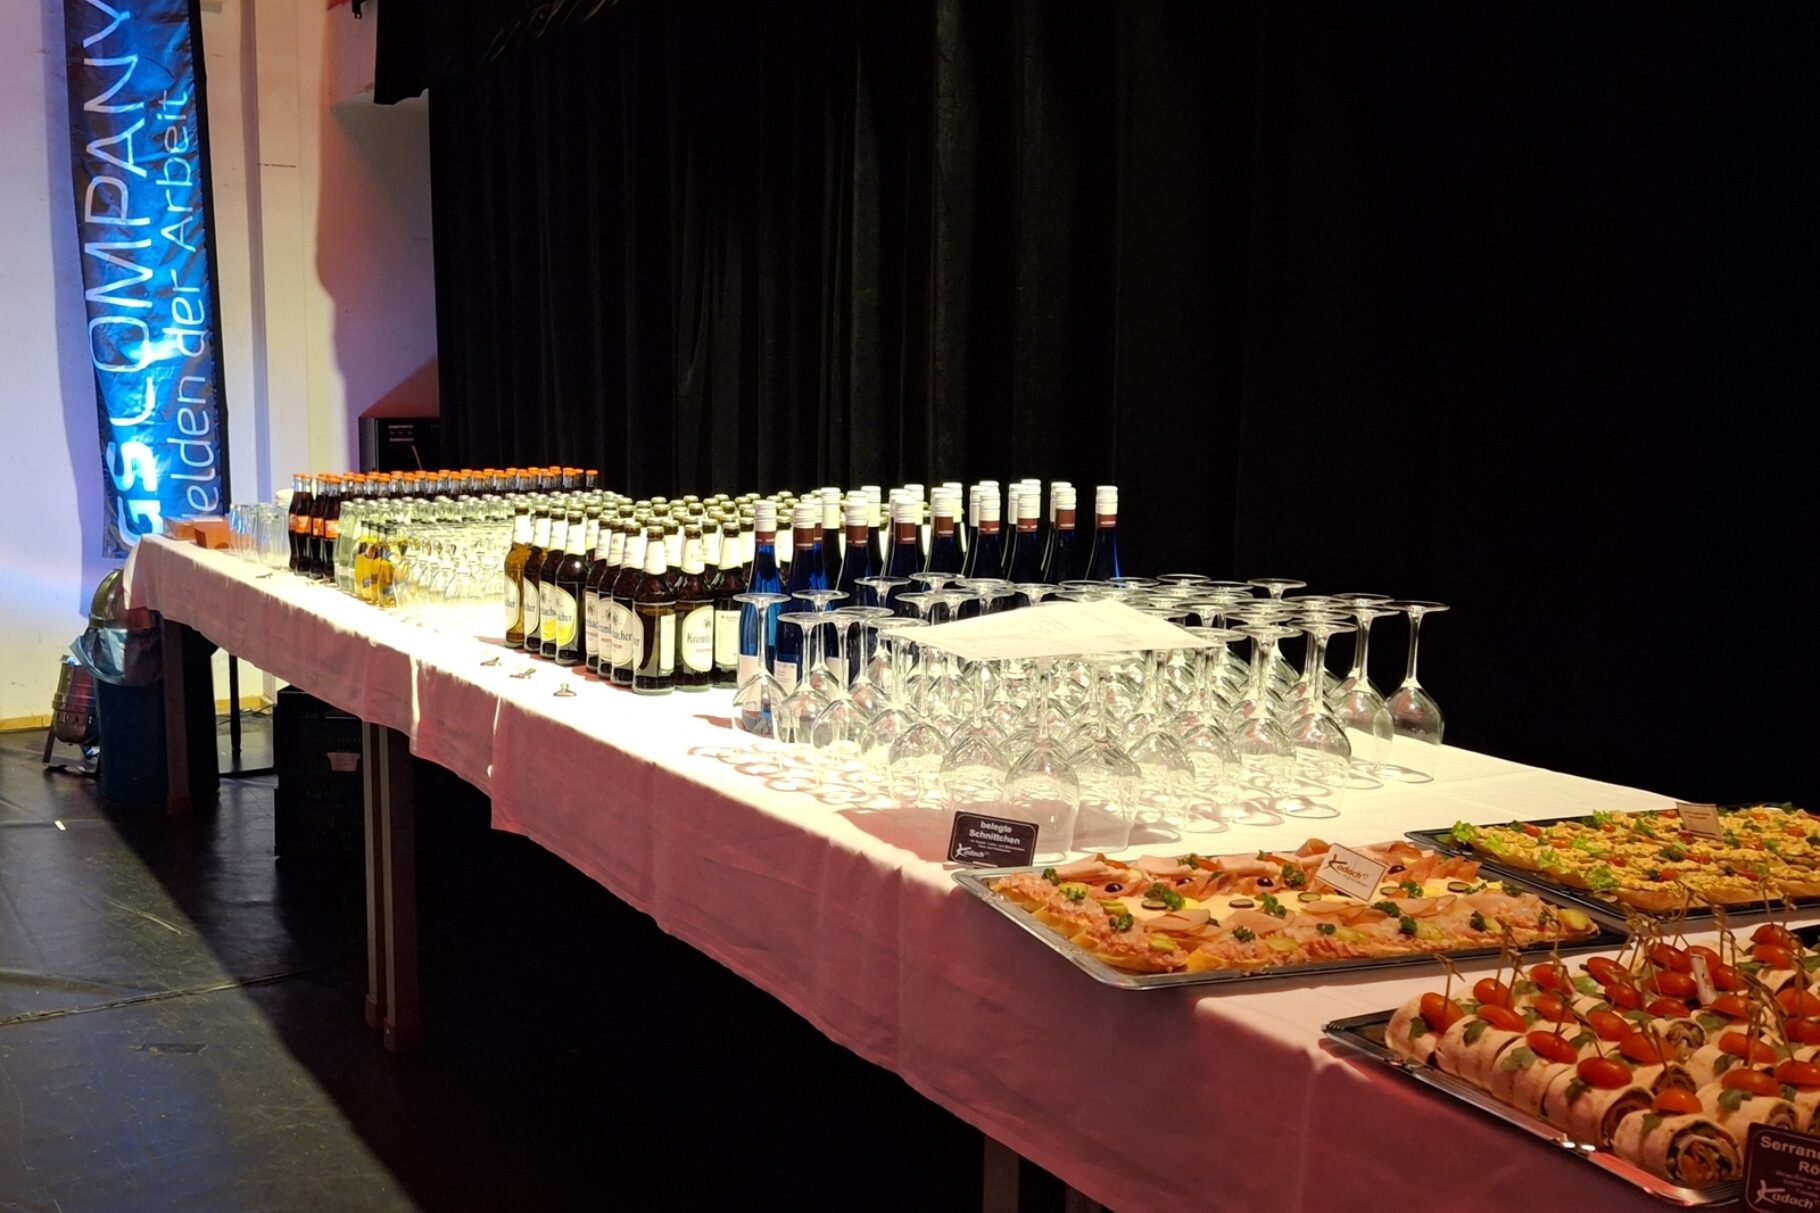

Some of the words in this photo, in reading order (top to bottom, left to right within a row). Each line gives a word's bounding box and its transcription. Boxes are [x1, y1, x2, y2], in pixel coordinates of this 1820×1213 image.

[156, 89, 197, 253] Arbeit
[162, 269, 206, 358] der
[167, 375, 220, 518] elden
[969, 829, 1021, 845] Schnittchen
[980, 820, 1012, 834] belegte
